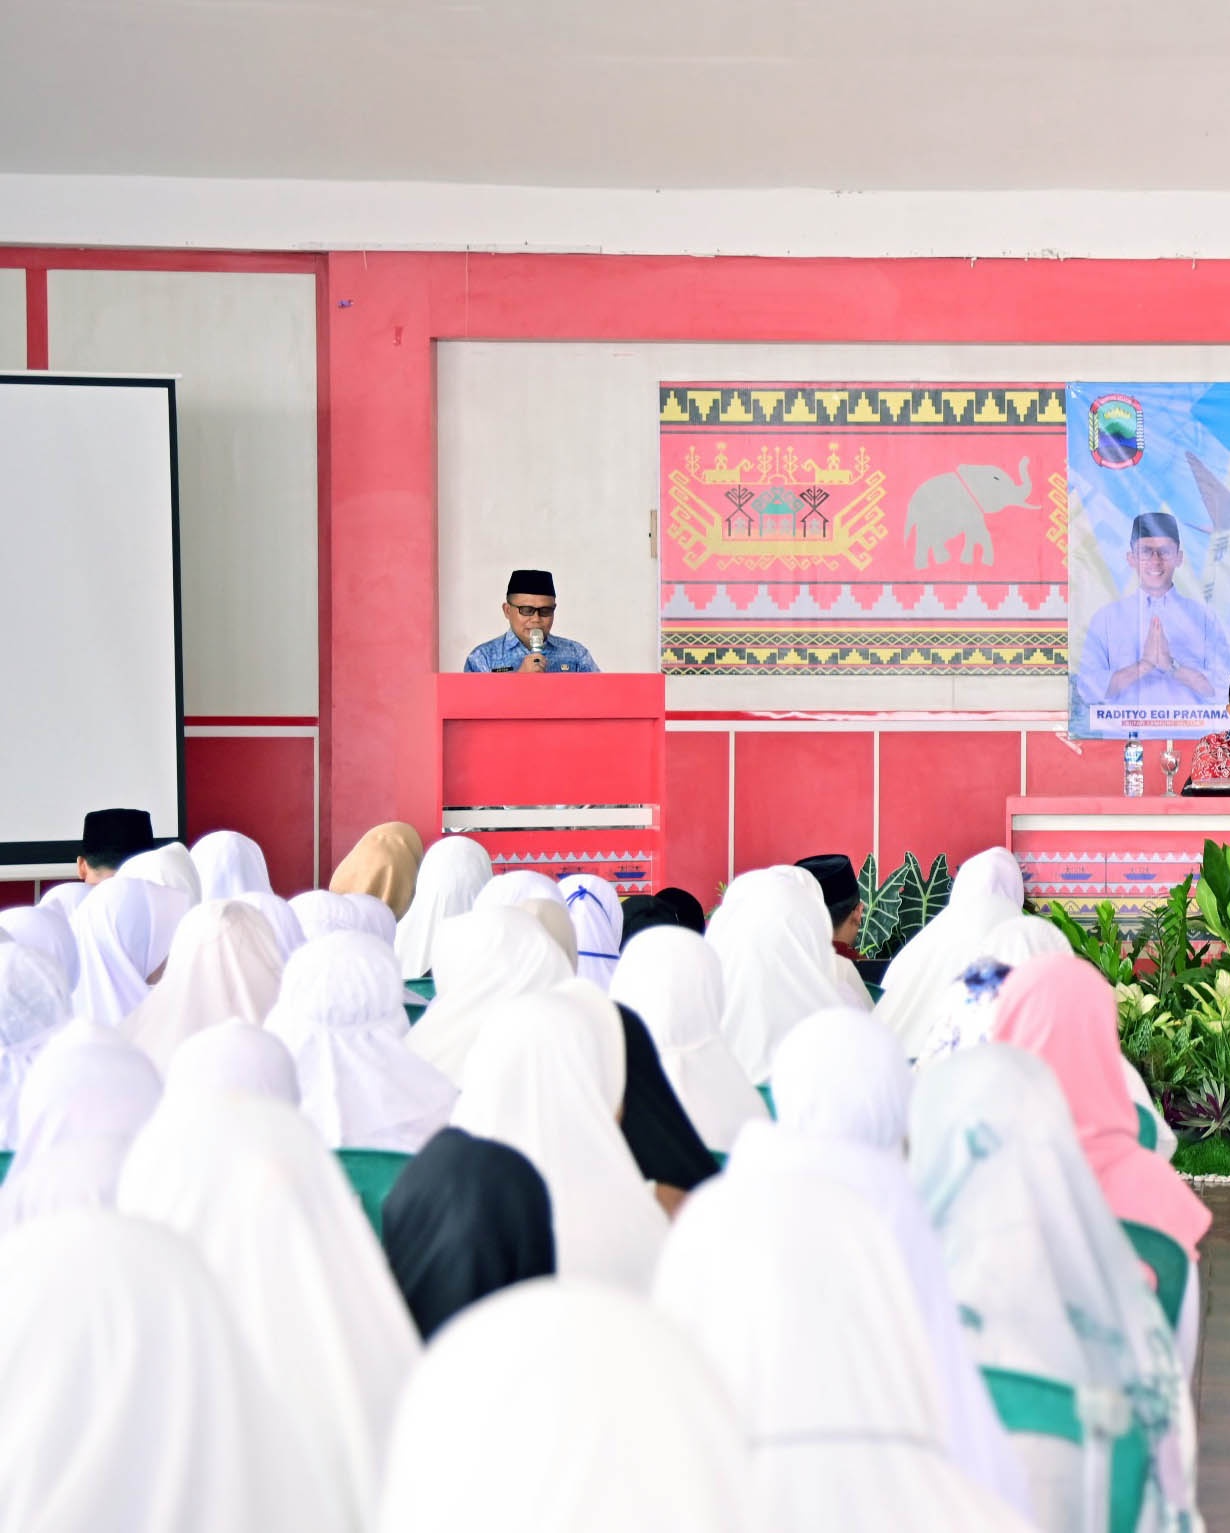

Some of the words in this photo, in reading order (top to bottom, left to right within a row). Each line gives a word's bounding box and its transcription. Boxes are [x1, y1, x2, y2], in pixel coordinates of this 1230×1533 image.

[1097, 710, 1147, 719] RADITYO
[1151, 710, 1170, 719] EGI
[1174, 710, 1228, 719] PRATAMA
